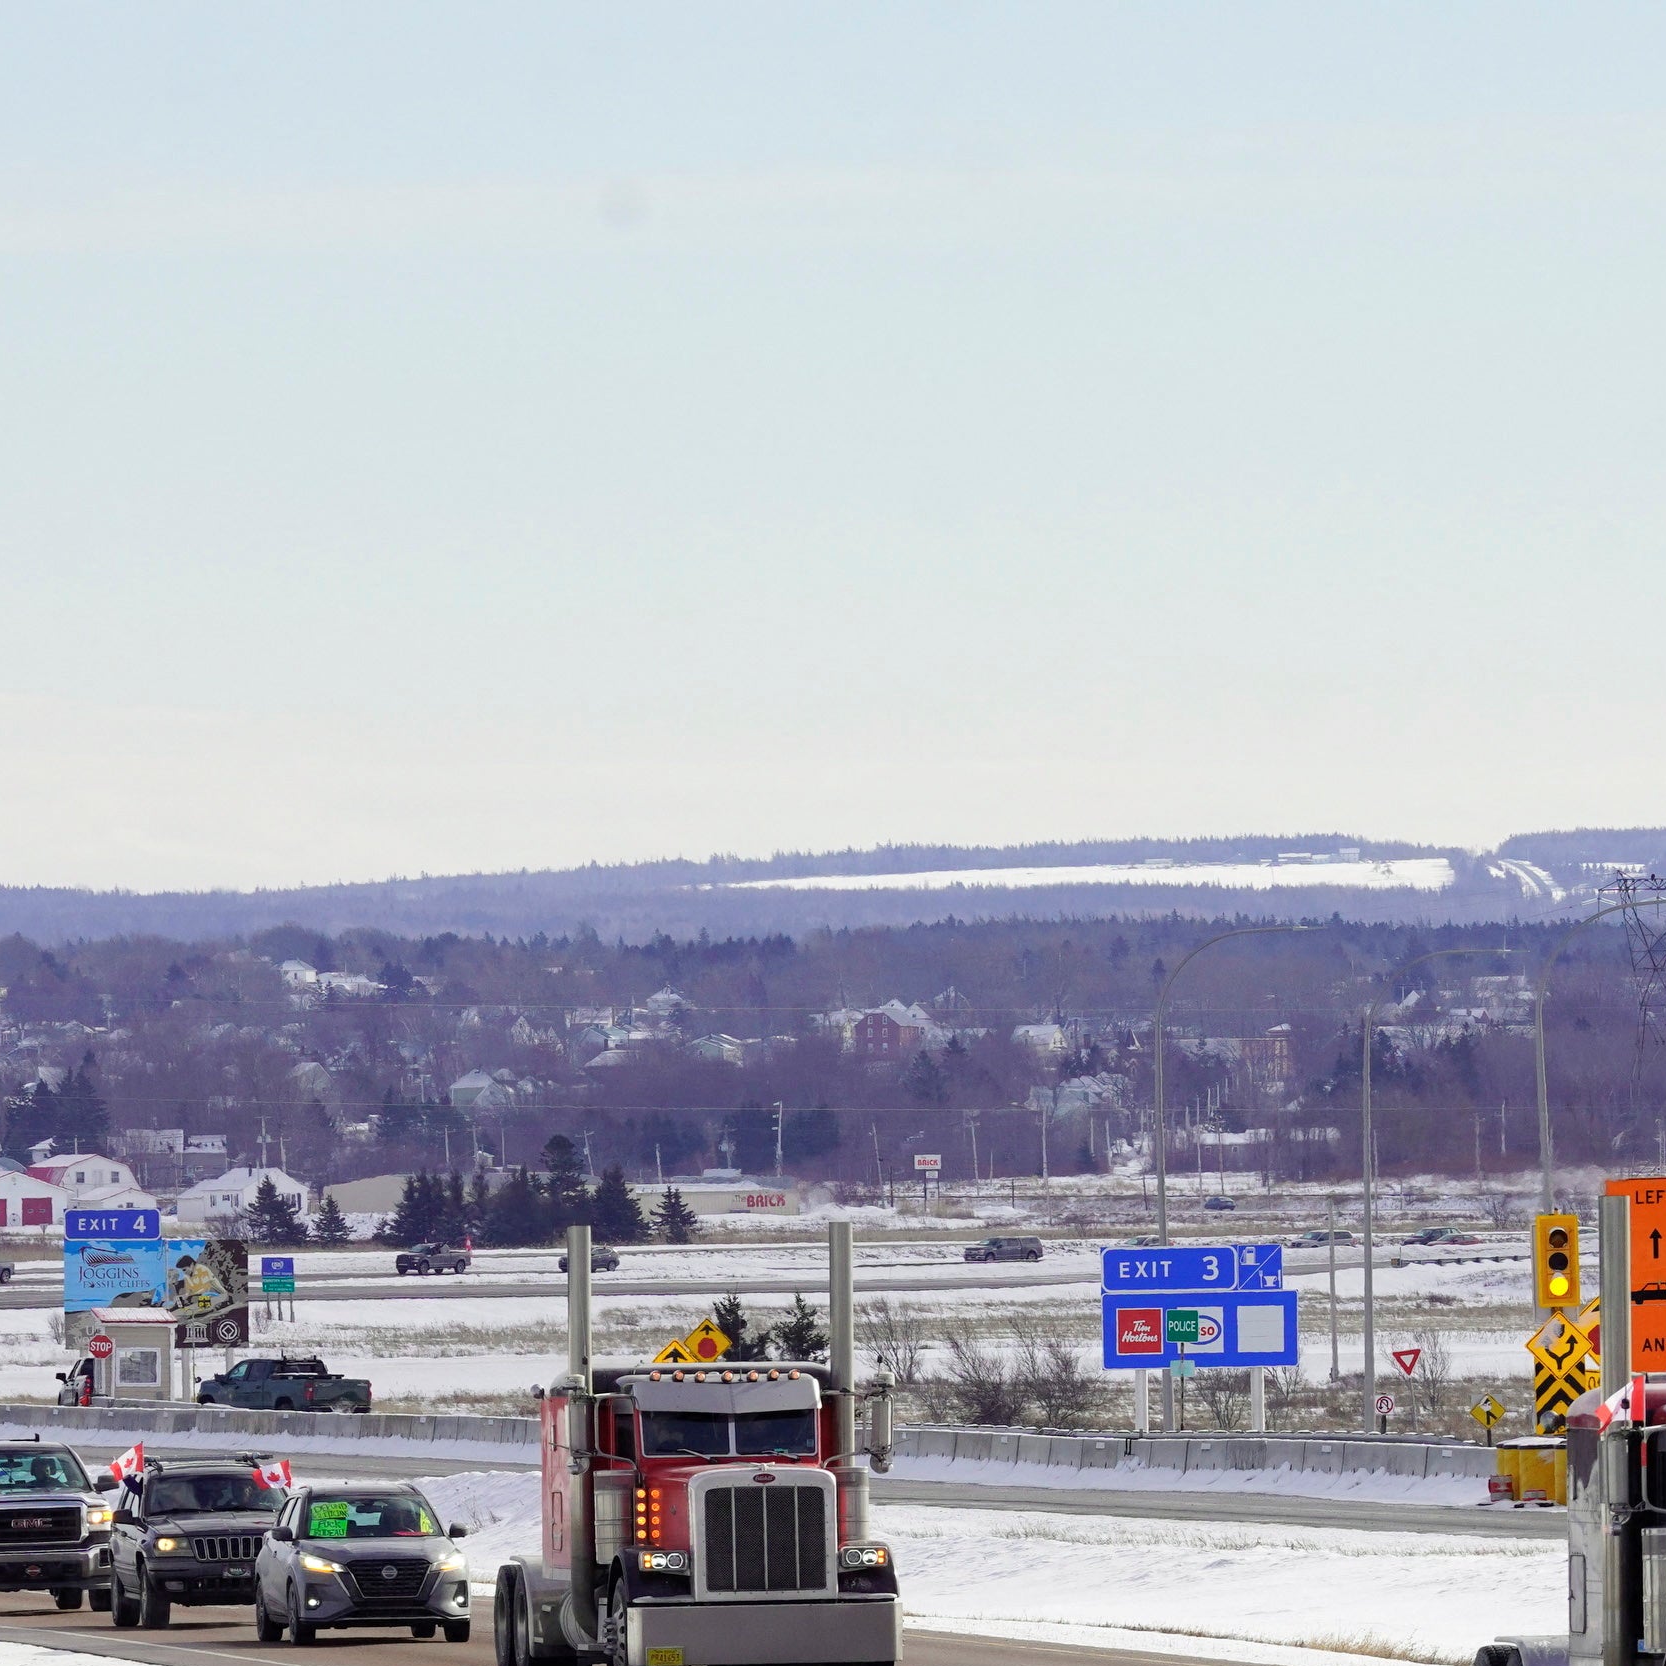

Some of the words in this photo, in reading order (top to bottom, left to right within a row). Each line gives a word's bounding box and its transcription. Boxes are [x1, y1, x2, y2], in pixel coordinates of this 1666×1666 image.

[747, 1193, 785, 1207] BRICK
[78, 1218, 118, 1231] EXIT
[133, 1215, 147, 1233] 4
[1119, 1261, 1172, 1278] EXIT
[1202, 1255, 1220, 1281] 3
[79, 1266, 139, 1282] JOGGINS
[119, 1280, 150, 1288] CLIFFS
[1133, 1320, 1151, 1332] Tim
[1169, 1321, 1196, 1331] POLICE
[1122, 1331, 1158, 1342] Hortons
[90, 1342, 112, 1352] STOP
[11, 1517, 52, 1528] GMC
